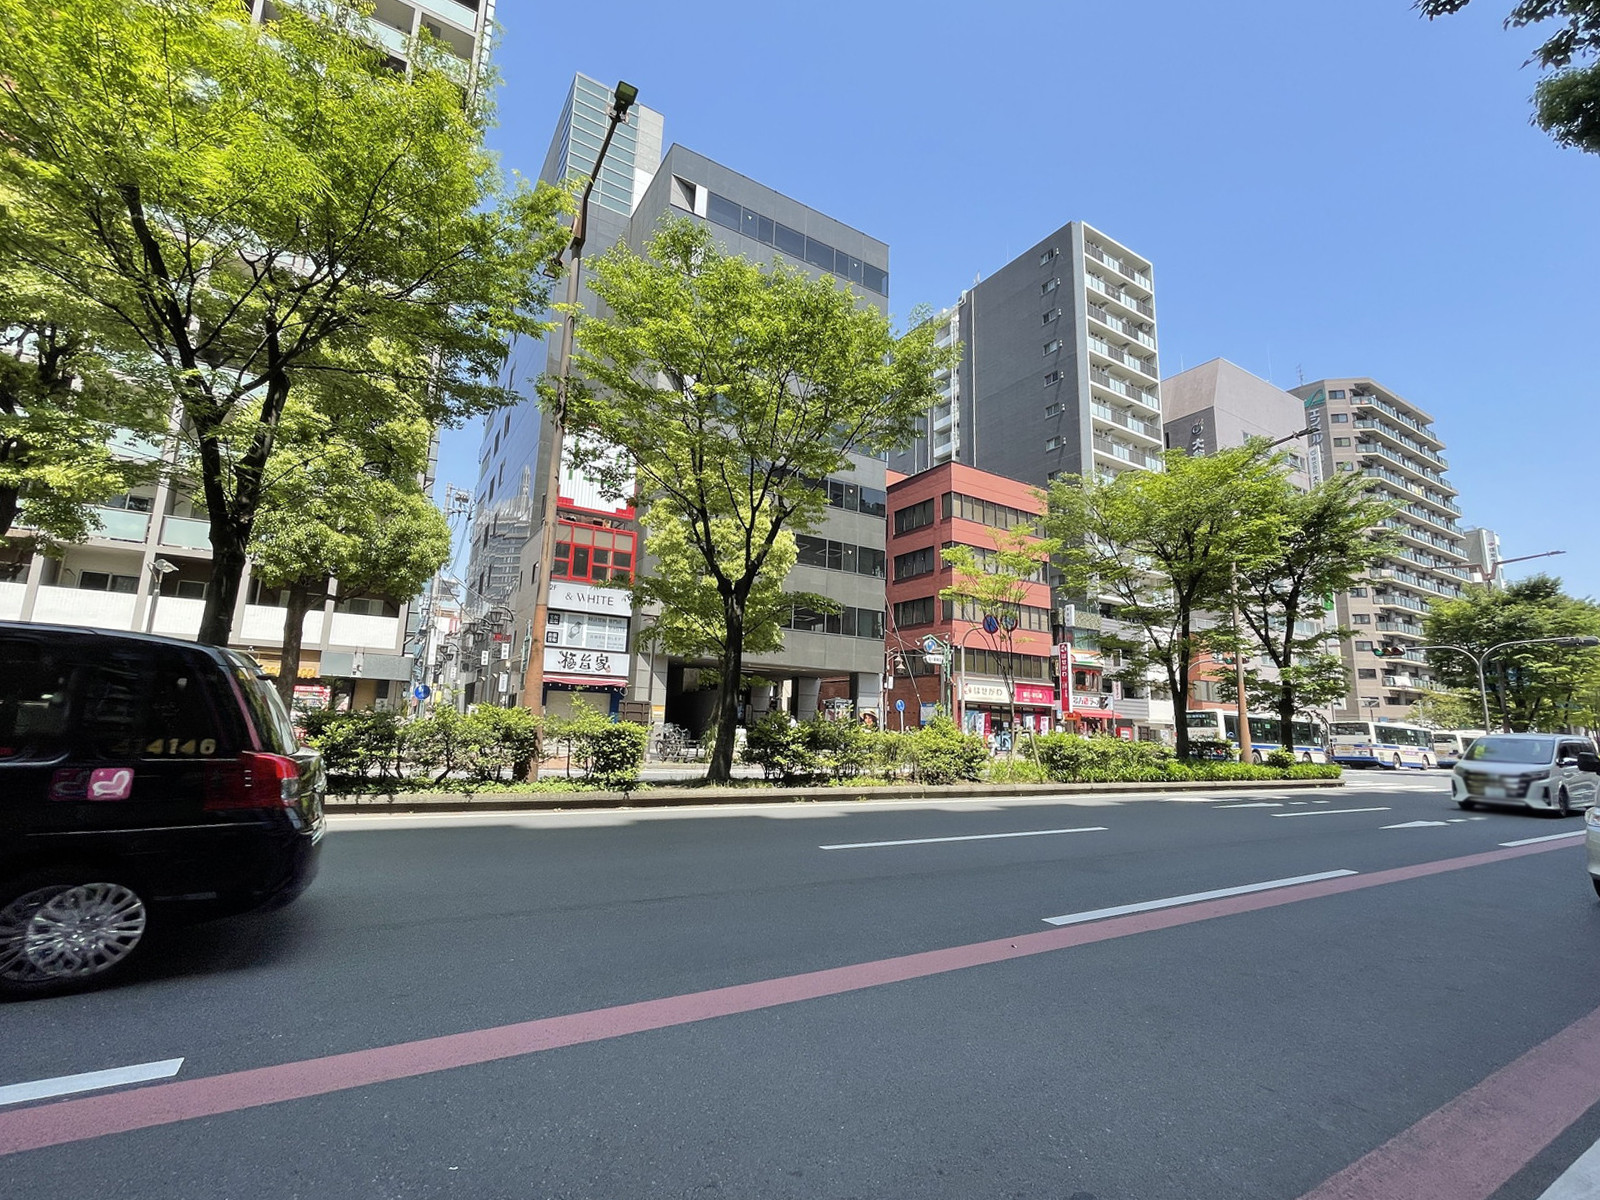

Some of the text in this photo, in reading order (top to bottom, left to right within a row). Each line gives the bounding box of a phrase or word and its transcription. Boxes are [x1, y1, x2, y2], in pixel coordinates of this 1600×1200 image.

[565, 592, 573, 601] &
[576, 592, 615, 606] WHITE
[973, 687, 1003, 697] はせがわ
